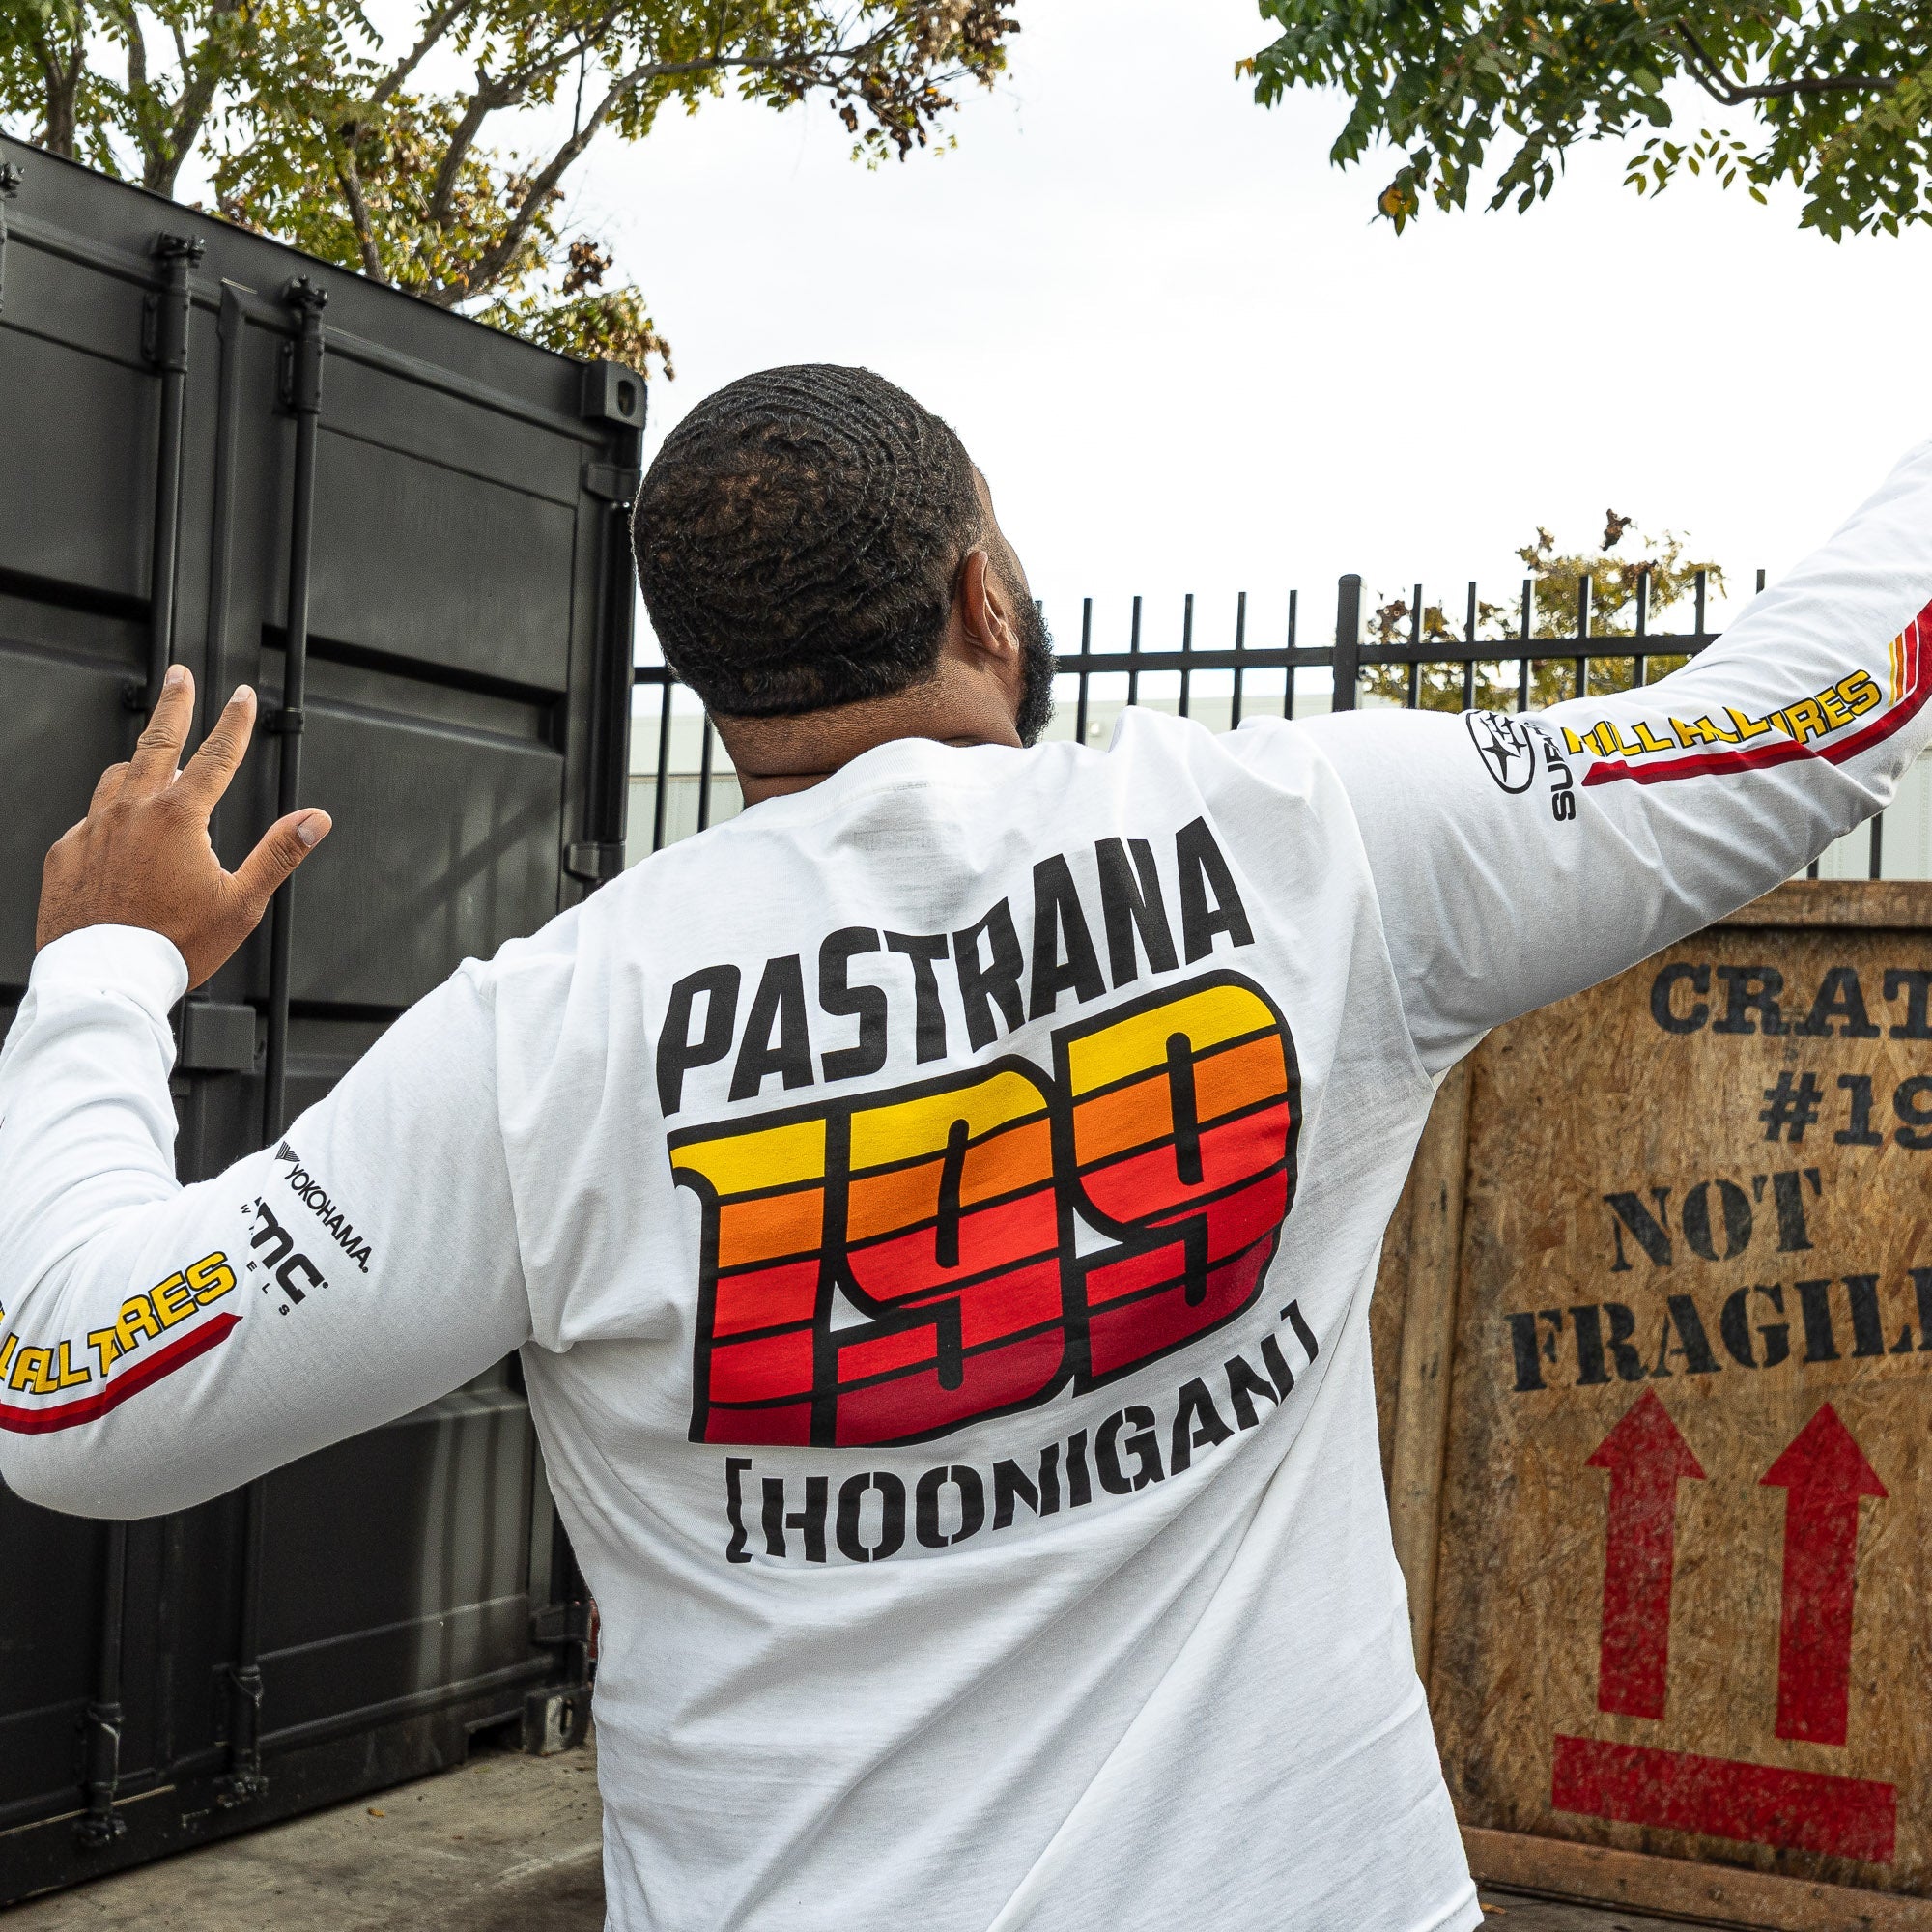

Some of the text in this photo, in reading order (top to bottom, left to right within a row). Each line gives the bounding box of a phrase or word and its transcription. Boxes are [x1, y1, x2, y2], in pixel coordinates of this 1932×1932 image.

[656, 816, 1255, 1118] PASTRANA
[284, 1163, 372, 1270] YOKOHAMA
[667, 969, 1302, 1449] 199
[1604, 1167, 1822, 1273] NOT
[87, 1251, 238, 1378] TRES
